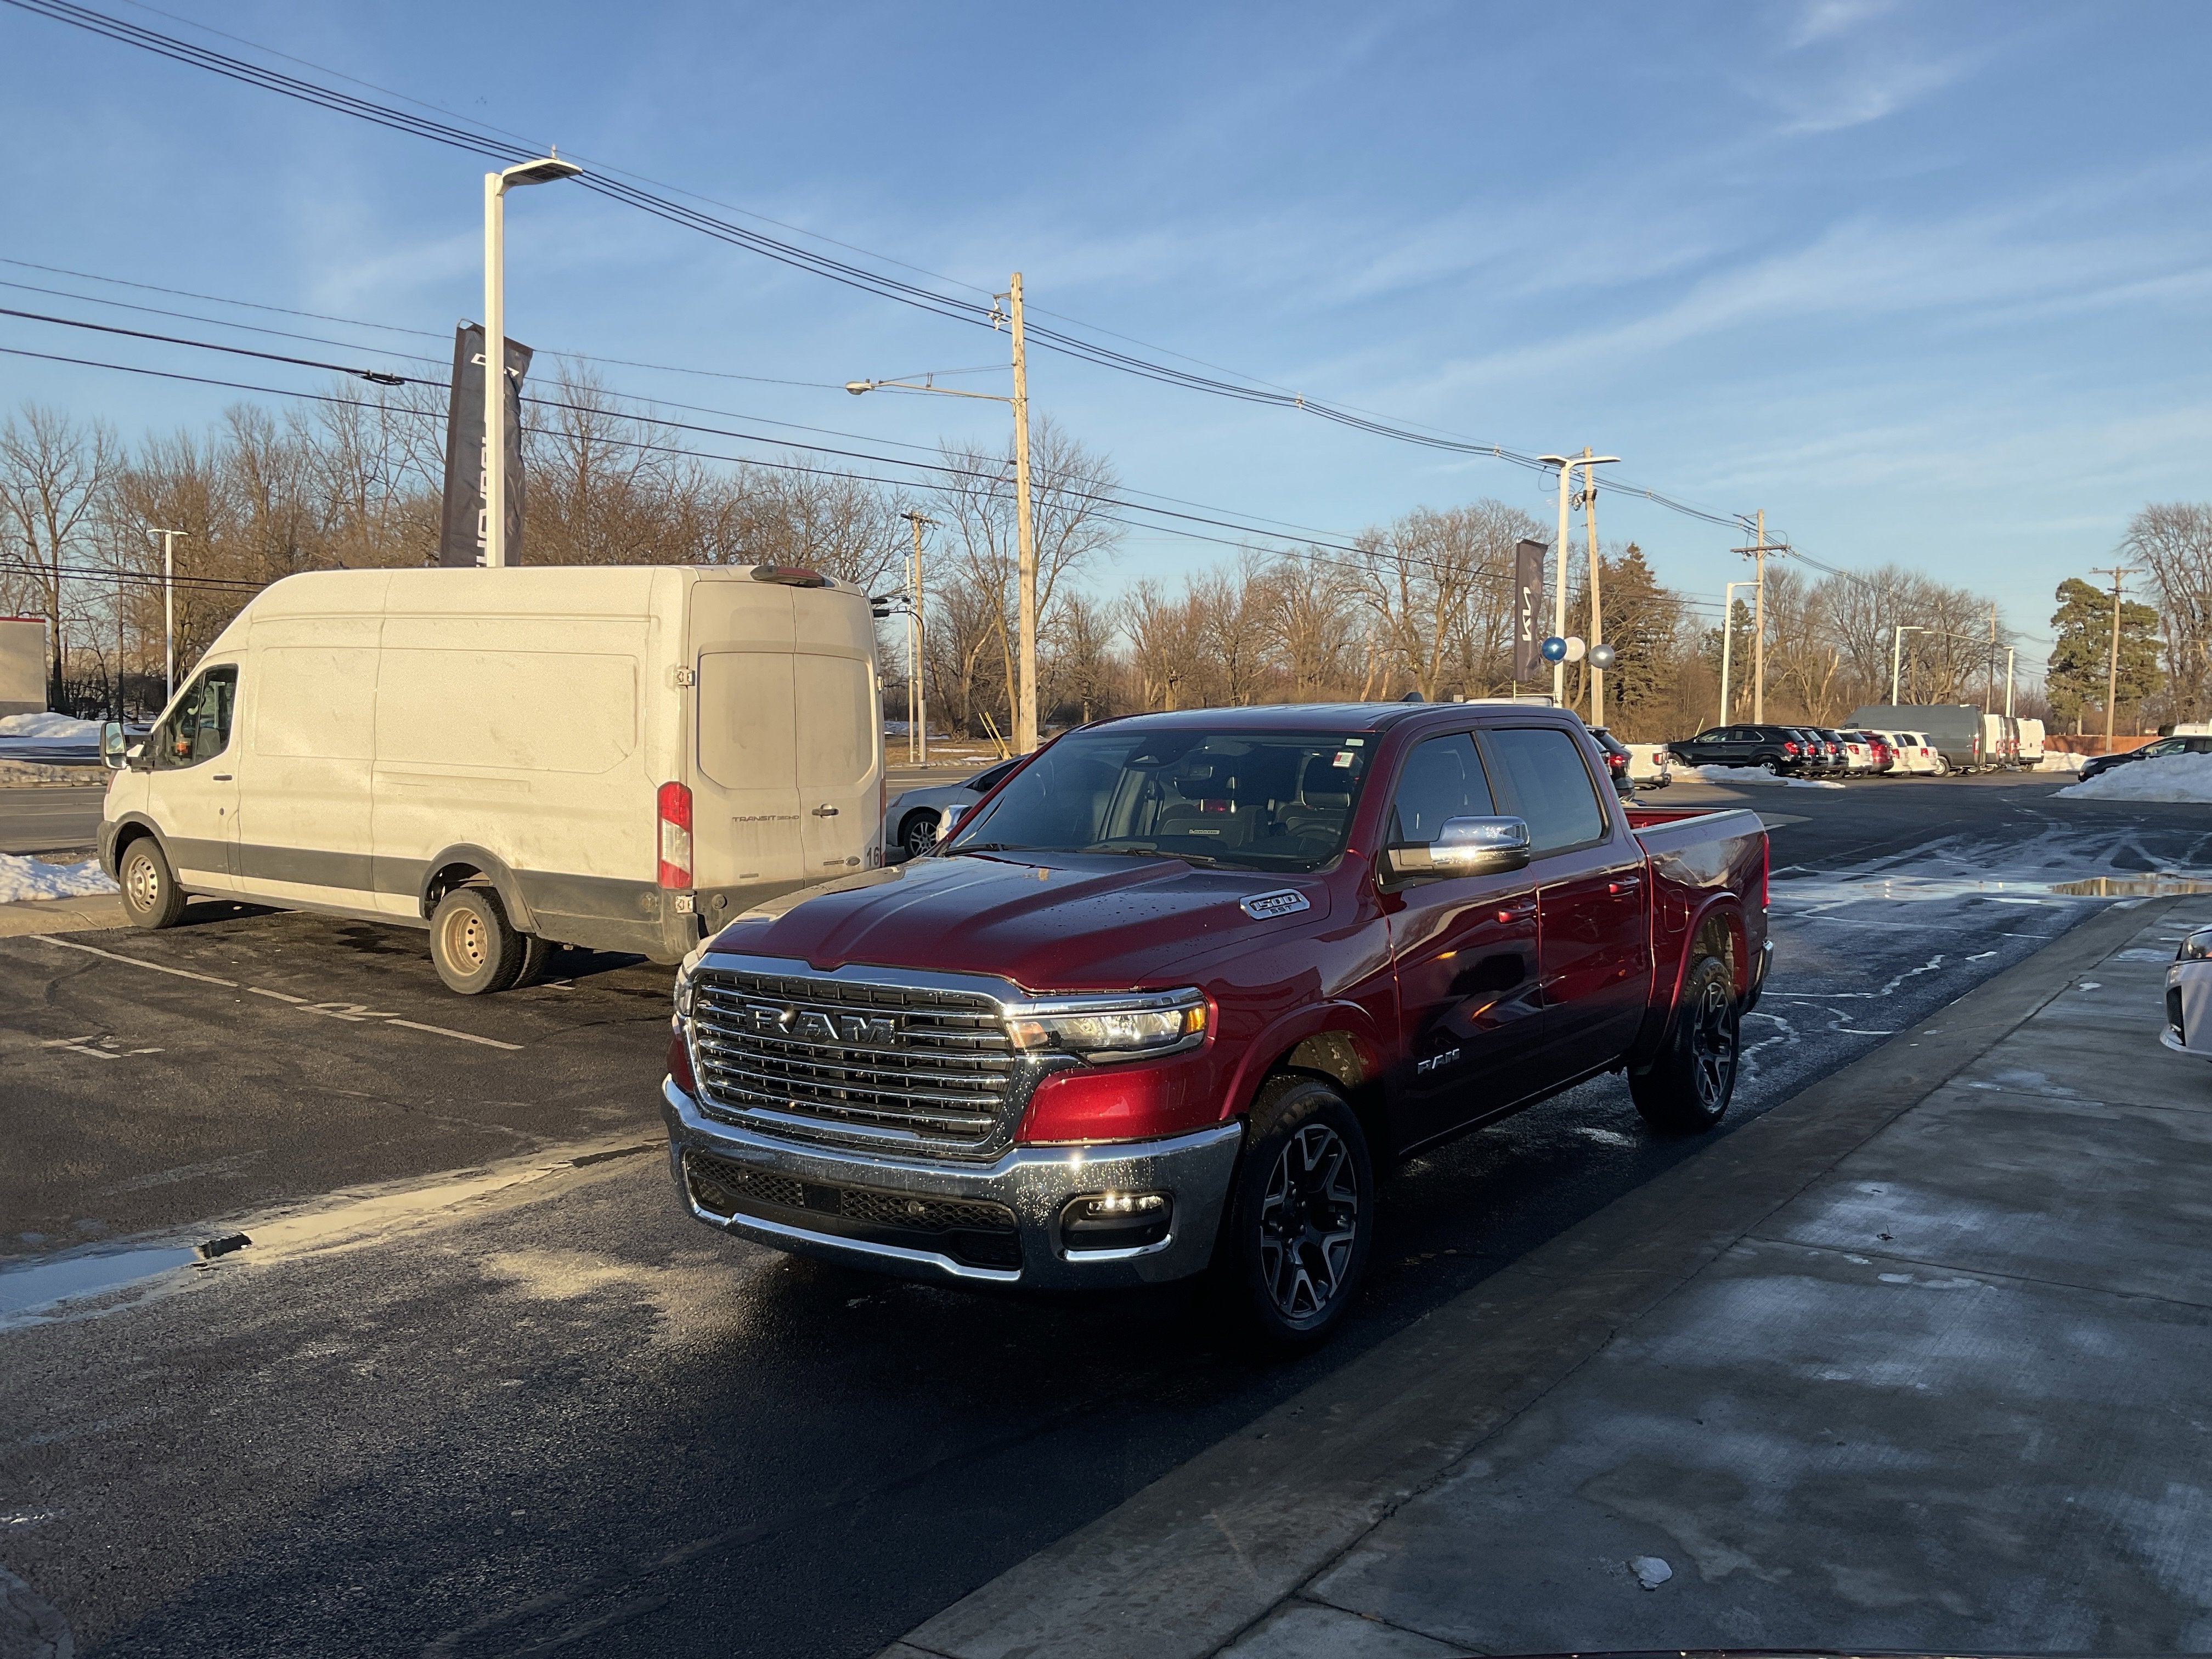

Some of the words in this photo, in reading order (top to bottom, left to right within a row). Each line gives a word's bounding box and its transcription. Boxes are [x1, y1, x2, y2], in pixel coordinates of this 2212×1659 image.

[1522, 586, 1532, 641] KIA
[867, 847, 879, 867] 16
[1251, 894, 1297, 911] 1500
[1269, 906, 1291, 914] SST
[746, 1003, 895, 1045] RAM
